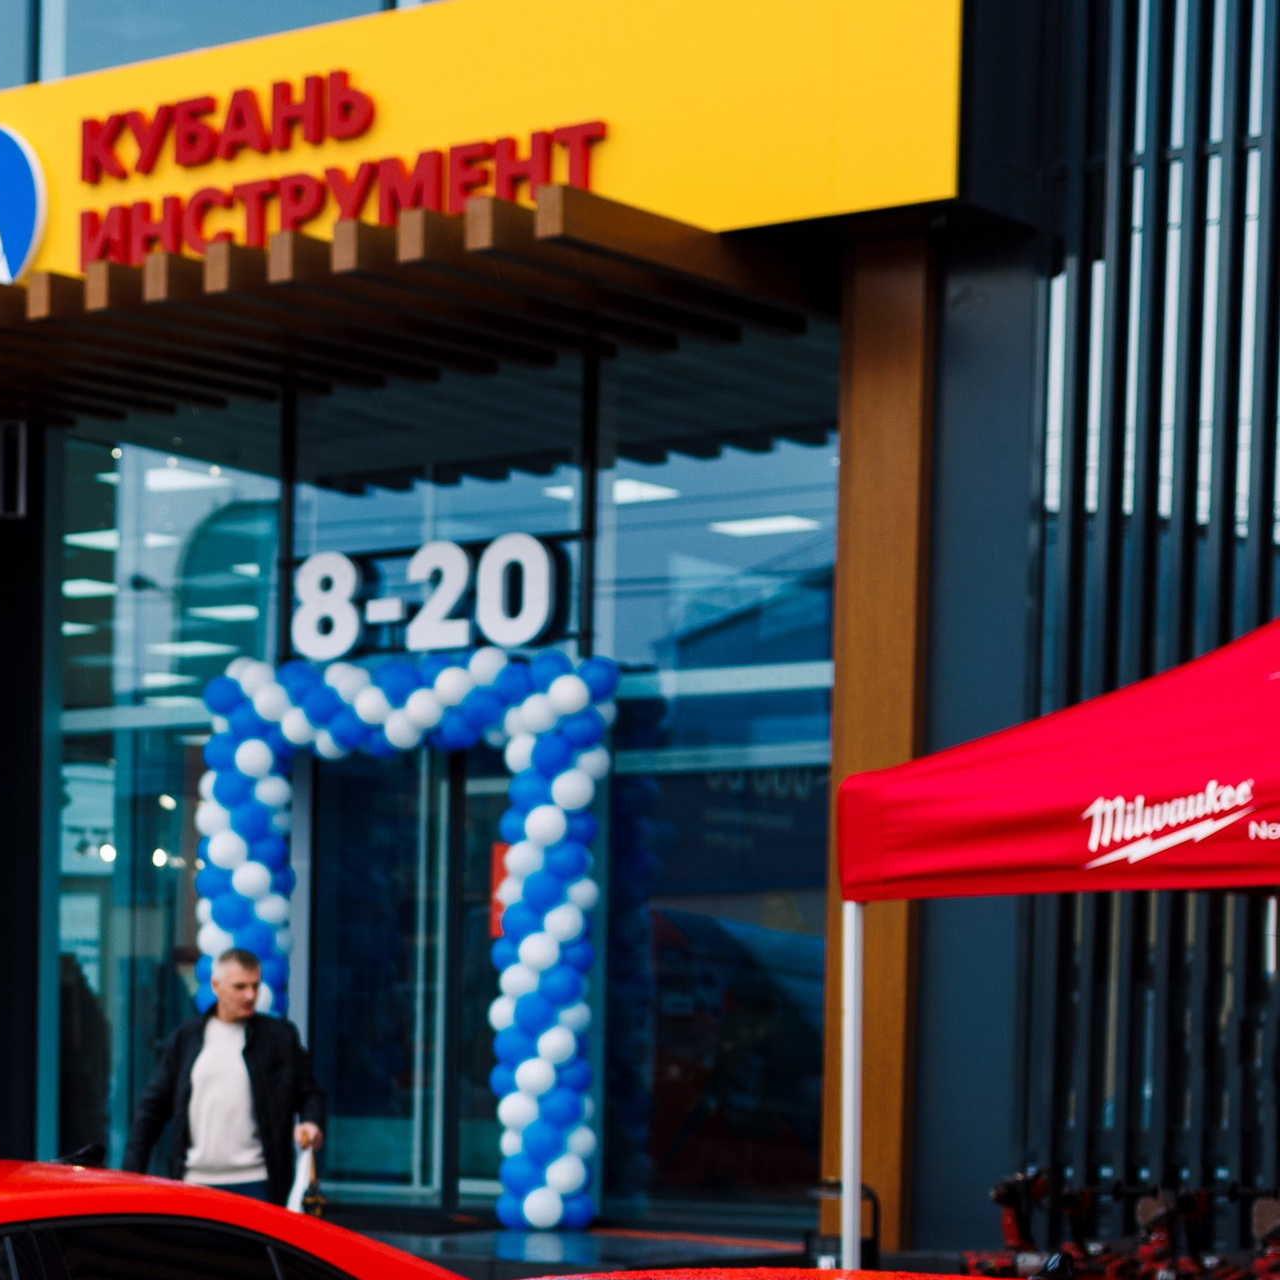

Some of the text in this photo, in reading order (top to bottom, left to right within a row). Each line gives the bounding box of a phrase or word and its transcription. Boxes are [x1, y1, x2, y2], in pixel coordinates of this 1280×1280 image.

[81, 70, 376, 185] КУБАНЬ
[80, 121, 606, 273] ИНСТРУМЕНТ
[291, 531, 552, 662] 8-20
[1079, 778, 1255, 853] Milwaukee
